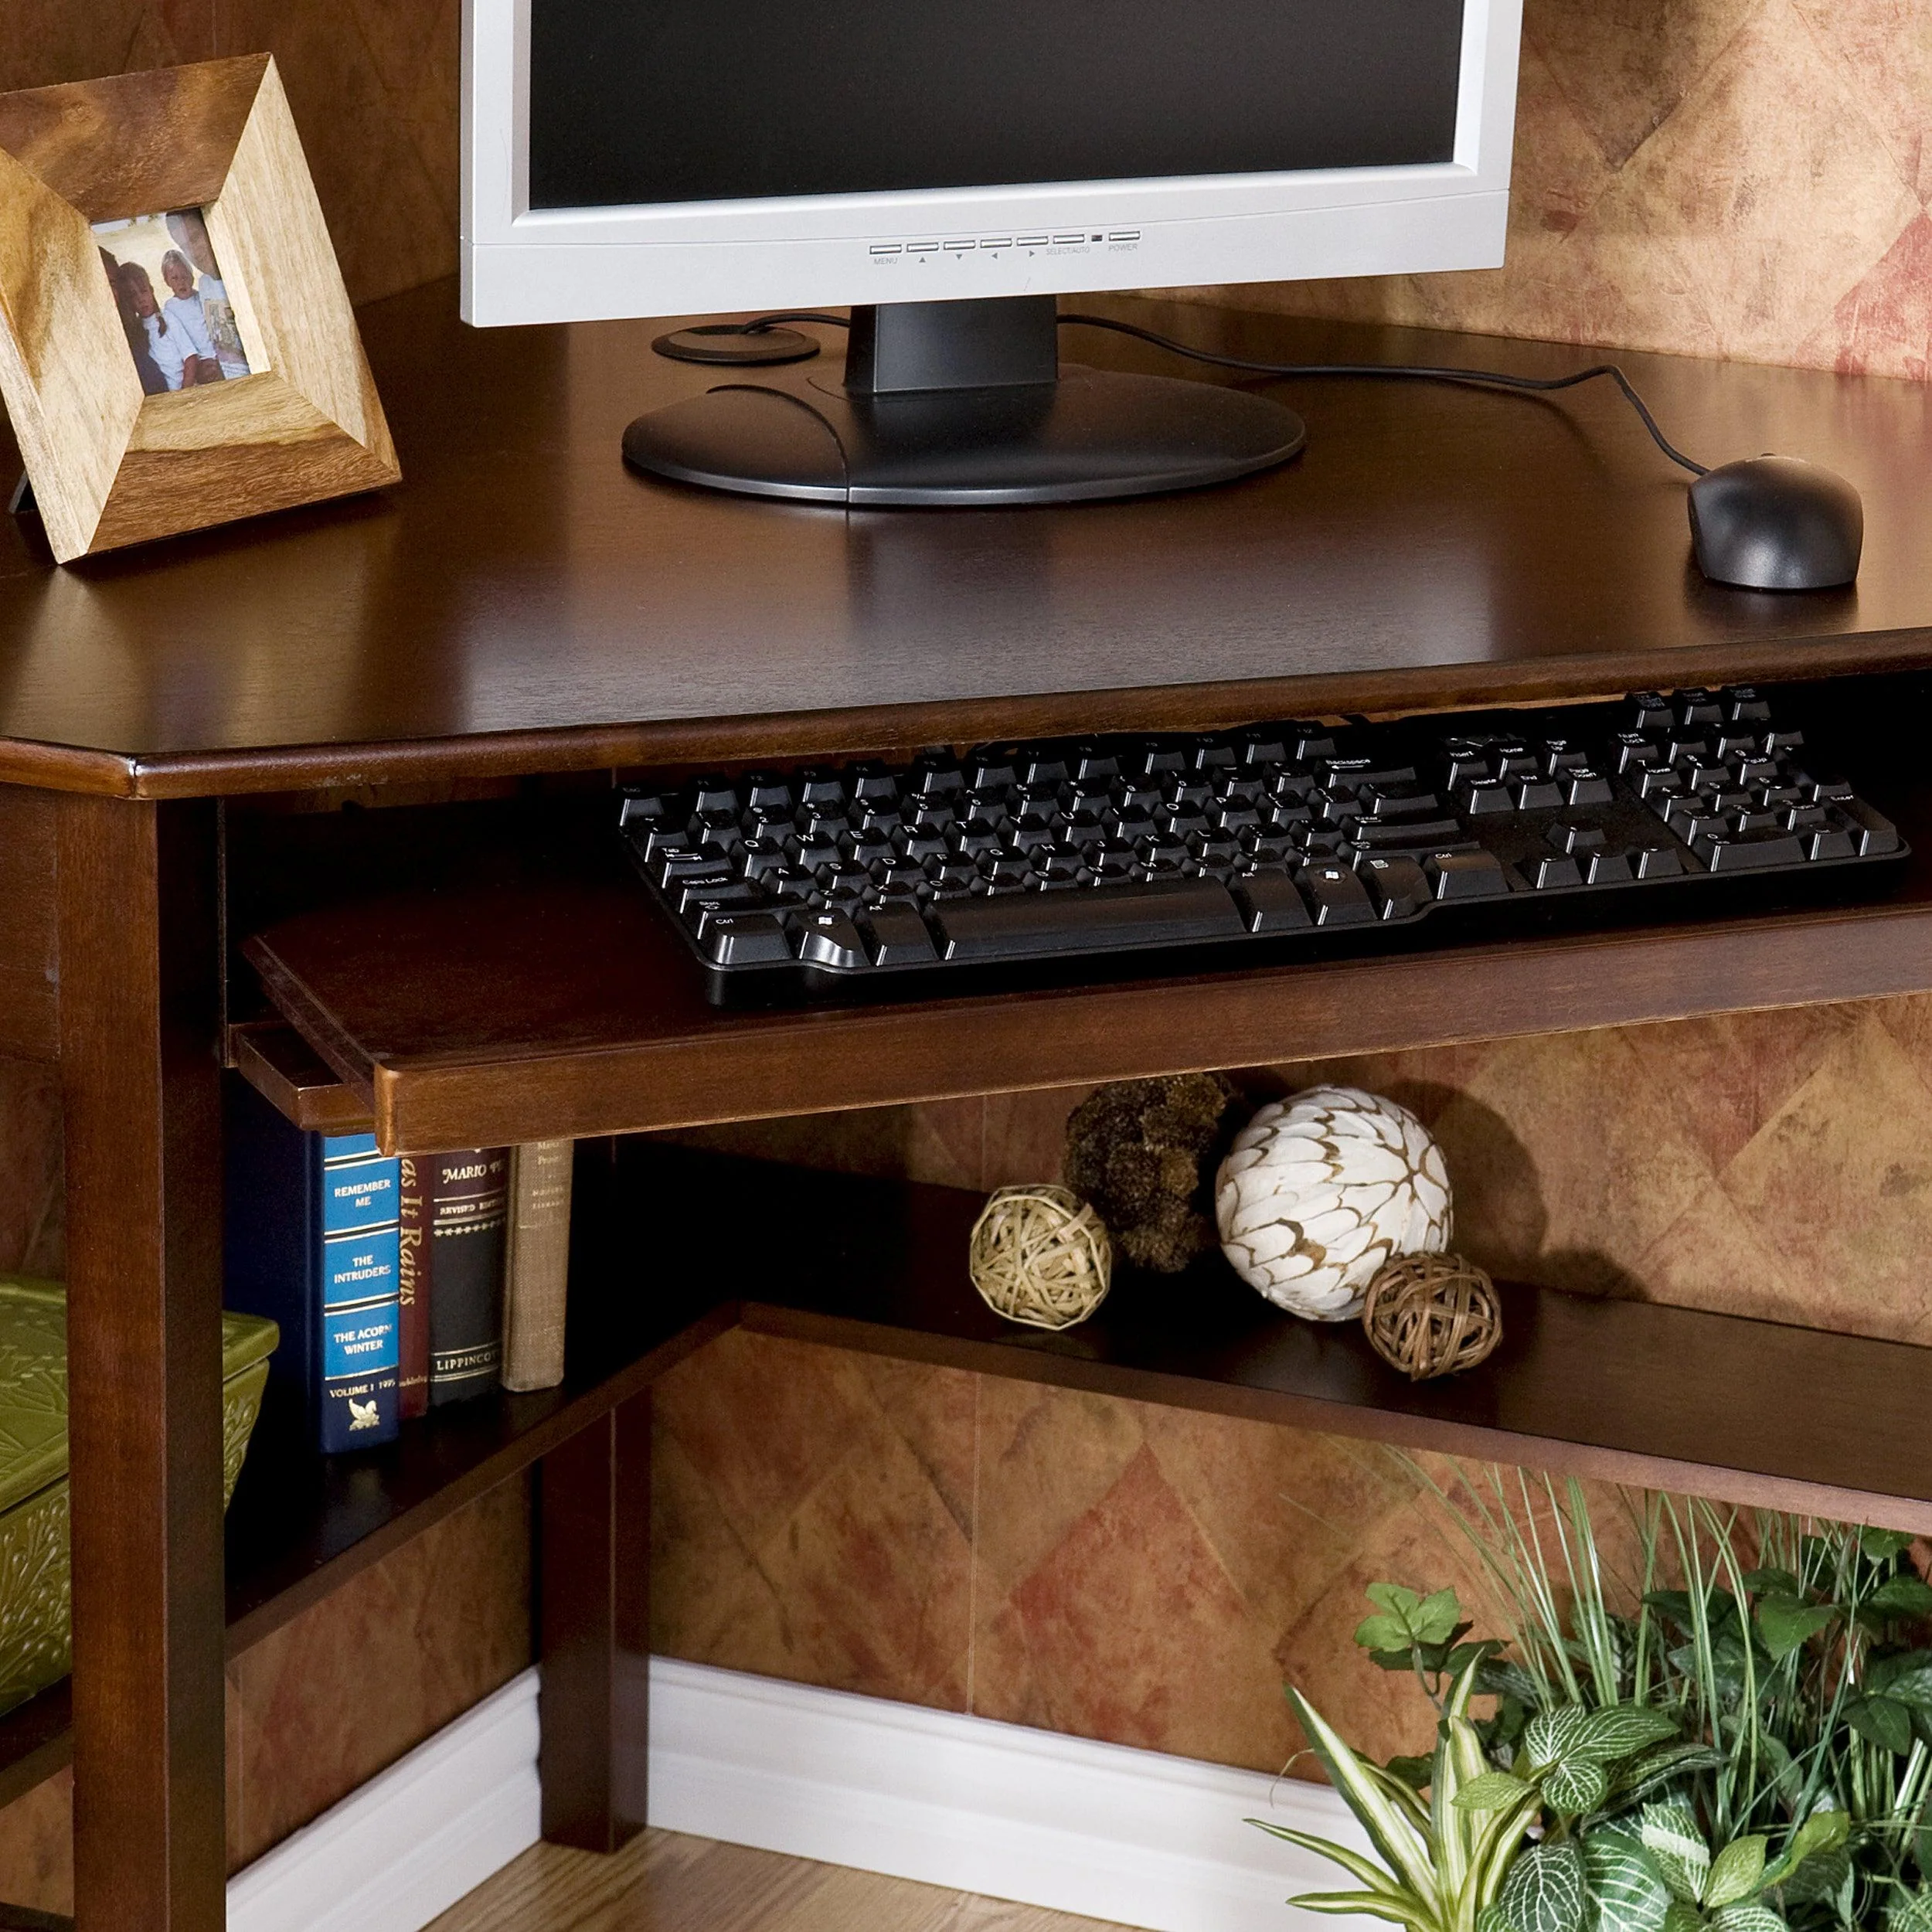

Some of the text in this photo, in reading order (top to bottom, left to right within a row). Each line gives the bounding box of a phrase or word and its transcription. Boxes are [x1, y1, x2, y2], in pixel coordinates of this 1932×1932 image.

[1108, 243, 1138, 252] POWER
[796, 834, 815, 842] W
[850, 831, 864, 839] E
[744, 839, 760, 849] Q
[442, 1164, 487, 1184] MARIO
[334, 1179, 391, 1198] REMEMBER
[355, 1196, 371, 1207] ME
[400, 1196, 423, 1219] It
[352, 1254, 373, 1267] THE
[400, 1226, 422, 1306] Rains
[334, 1264, 391, 1284] INTRUDERS
[333, 1324, 393, 1343] THE ACORN
[344, 1339, 384, 1355] WINTER
[329, 1385, 369, 1398] VOLUME
